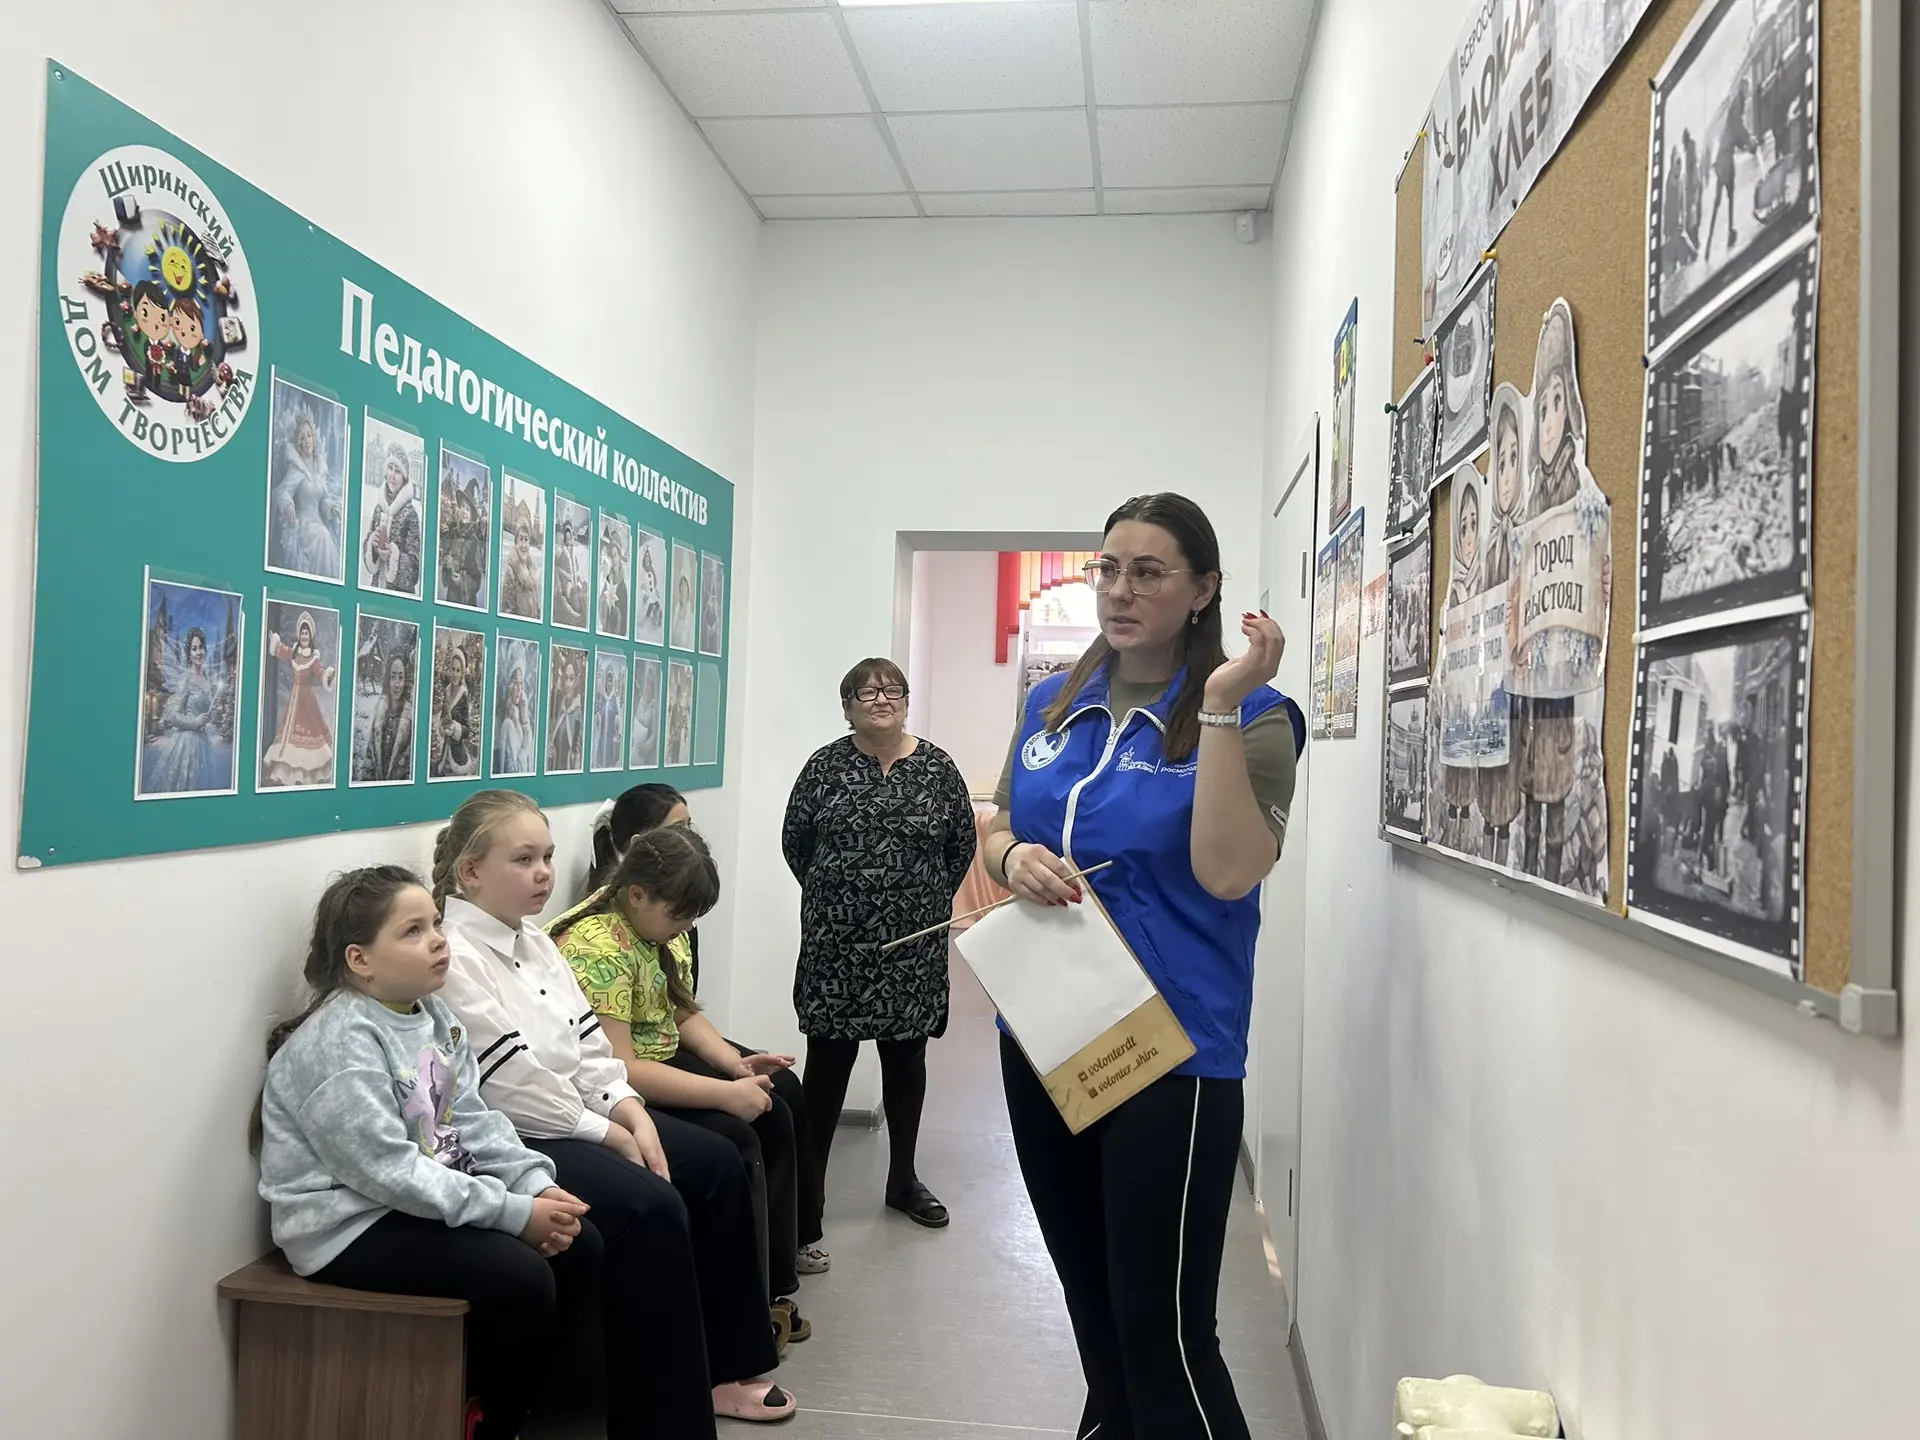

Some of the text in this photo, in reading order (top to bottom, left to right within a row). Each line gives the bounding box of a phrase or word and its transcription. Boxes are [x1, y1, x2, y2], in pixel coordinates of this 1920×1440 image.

[1460, 0, 1499, 77] ВСЕРОСС
[1488, 48, 1553, 212] ХЛЕБ
[98, 160, 234, 258] Ширинский
[60, 294, 254, 456] ДОМ ТВОРЧЕСТВА
[340, 276, 708, 526] Педагогический коллектив
[1098, 1047, 1158, 1092] volonter_shira
